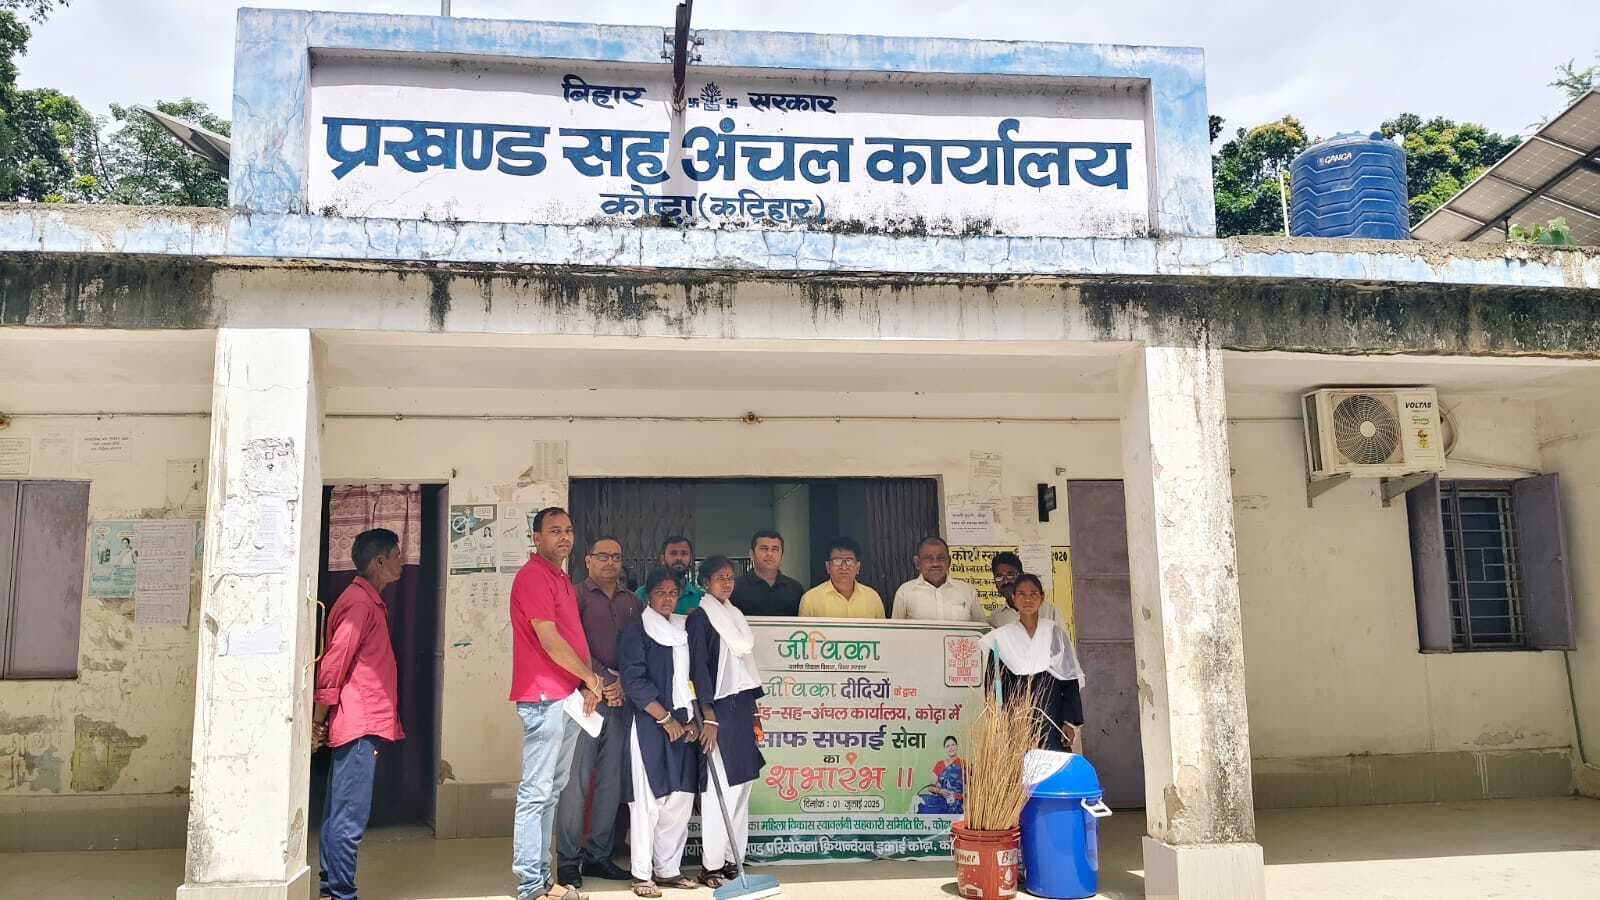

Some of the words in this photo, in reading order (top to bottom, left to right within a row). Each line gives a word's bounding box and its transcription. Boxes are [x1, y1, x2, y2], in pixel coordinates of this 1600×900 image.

[561, 74, 646, 108] बिहार
[747, 92, 837, 113] सरकार
[322, 116, 550, 180] प्रखण्ड
[559, 127, 670, 184] सह
[681, 117, 854, 182] अंचल
[865, 118, 1132, 190] कार्यालय
[1324, 152, 1352, 164] GANGA
[1405, 401, 1432, 409] VOLTAS
[774, 630, 880, 660] जीविका
[762, 676, 838, 697] जीविका
[840, 677, 891, 699] दीदियों
[949, 704, 962, 720] में
[812, 725, 887, 750] सफाई
[892, 726, 927, 749] सेवा
[824, 753, 840, 765] का
[766, 752, 888, 801] शुभारंभ
[864, 800, 880, 808] 2025
